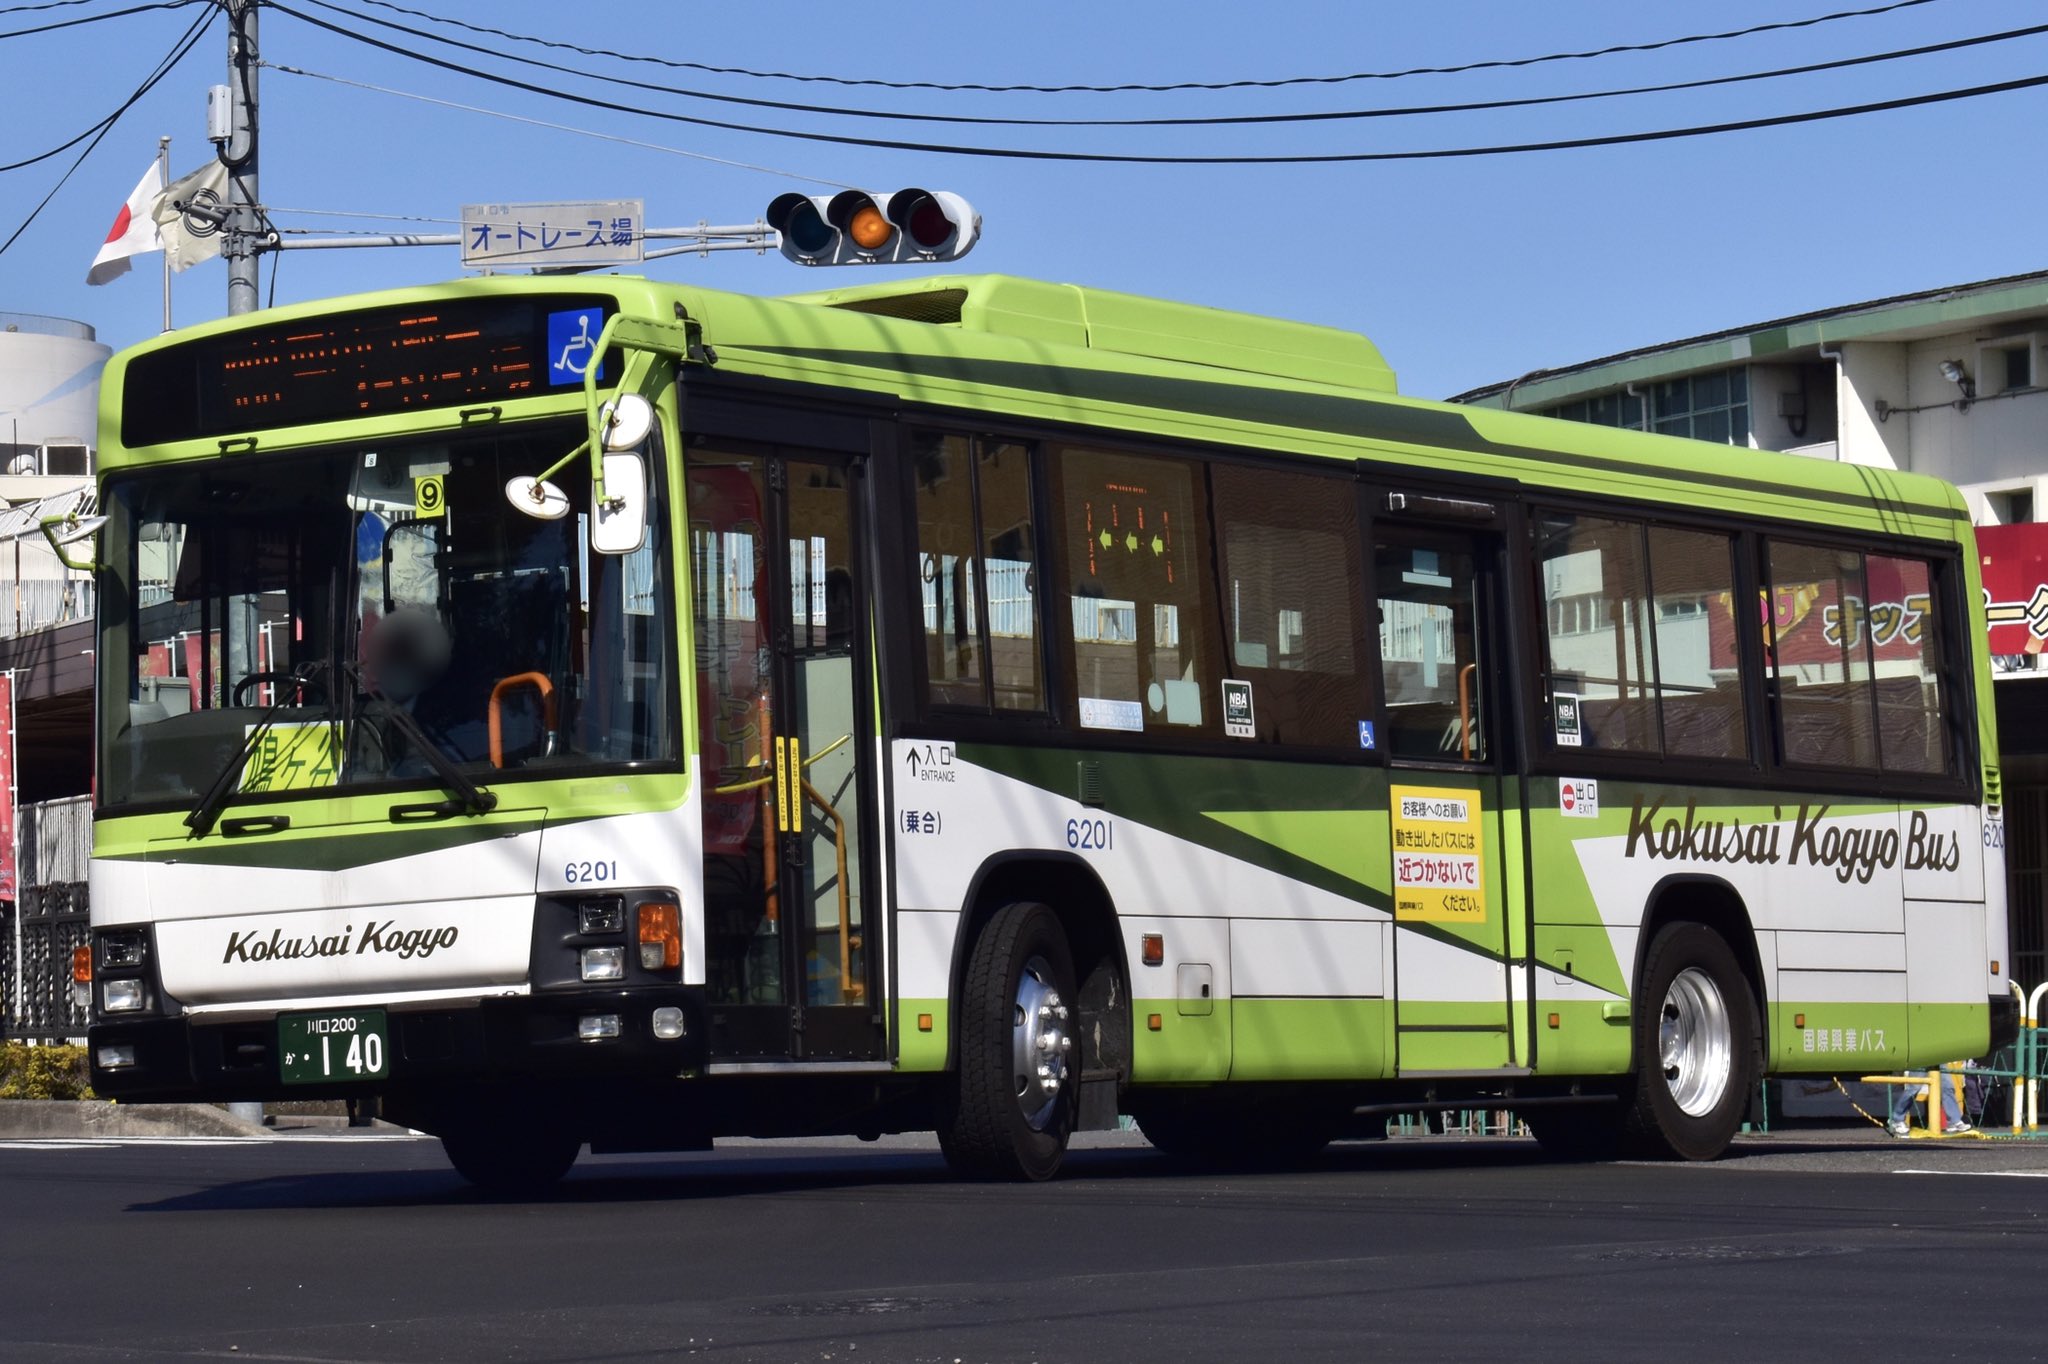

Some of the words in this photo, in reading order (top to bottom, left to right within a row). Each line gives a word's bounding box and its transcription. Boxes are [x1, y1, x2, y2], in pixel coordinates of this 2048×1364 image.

[471, 218, 632, 251] オートレース場
[1229, 692, 1248, 707] NBA
[1558, 704, 1575, 717] NBA
[925, 745, 951, 766] 入口
[921, 769, 956, 783] ENTRANCE
[1575, 782, 1595, 800] 出口
[1402, 800, 1467, 819] お客様へのお願い
[1578, 803, 1593, 815] EXIT
[900, 809, 942, 835] (乗合)
[1067, 818, 1113, 850] 6201
[1395, 828, 1475, 850] 動き出したバスには
[1624, 793, 1781, 865] Kokusai
[1788, 800, 1898, 885] Kogyo
[1903, 810, 1960, 873] Bus
[565, 860, 616, 883] 6201
[1399, 857, 1475, 884] 近づかないで
[223, 924, 352, 964] Kokusai
[356, 920, 458, 960] Kogyo
[1803, 1028, 1886, 1053] 国際興業バス
